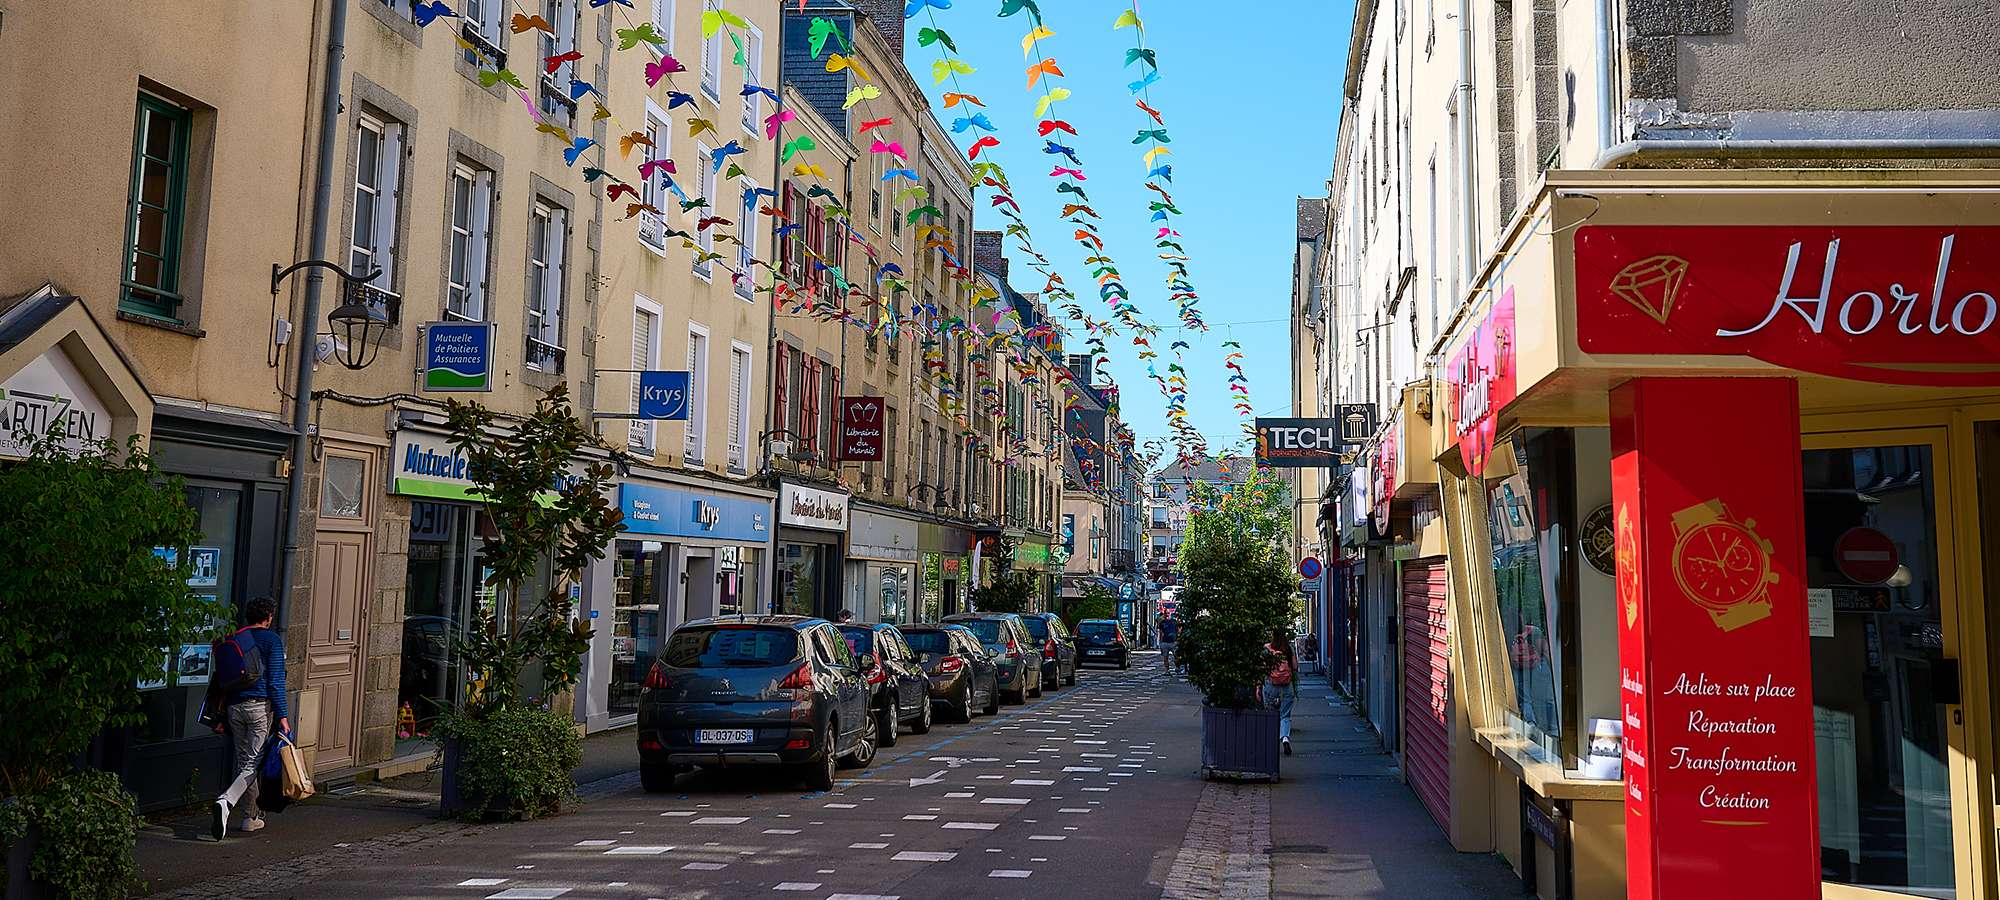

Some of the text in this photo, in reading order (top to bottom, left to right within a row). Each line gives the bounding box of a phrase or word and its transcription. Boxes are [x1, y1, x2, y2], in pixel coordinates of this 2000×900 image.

[435, 333, 473, 342] Mutuelle
[434, 344, 479, 353] de Poitiers
[434, 355, 481, 363] Assurances
[643, 385, 681, 405] Krys
[846, 427, 880, 436] Librairie
[856, 437, 869, 446] du
[848, 446, 876, 455] Marais
[404, 443, 465, 480] Mutuelle
[700, 500, 720, 531] Krys
[1587, 521, 1596, 530] 10
[1588, 552, 1596, 560] 8
[1602, 563, 1608, 571] 7
[1664, 672, 1796, 702] Atelier sur place
[1688, 709, 1776, 739] Réparation
[1669, 746, 1797, 776] Transformation
[1699, 784, 1770, 809] Création
